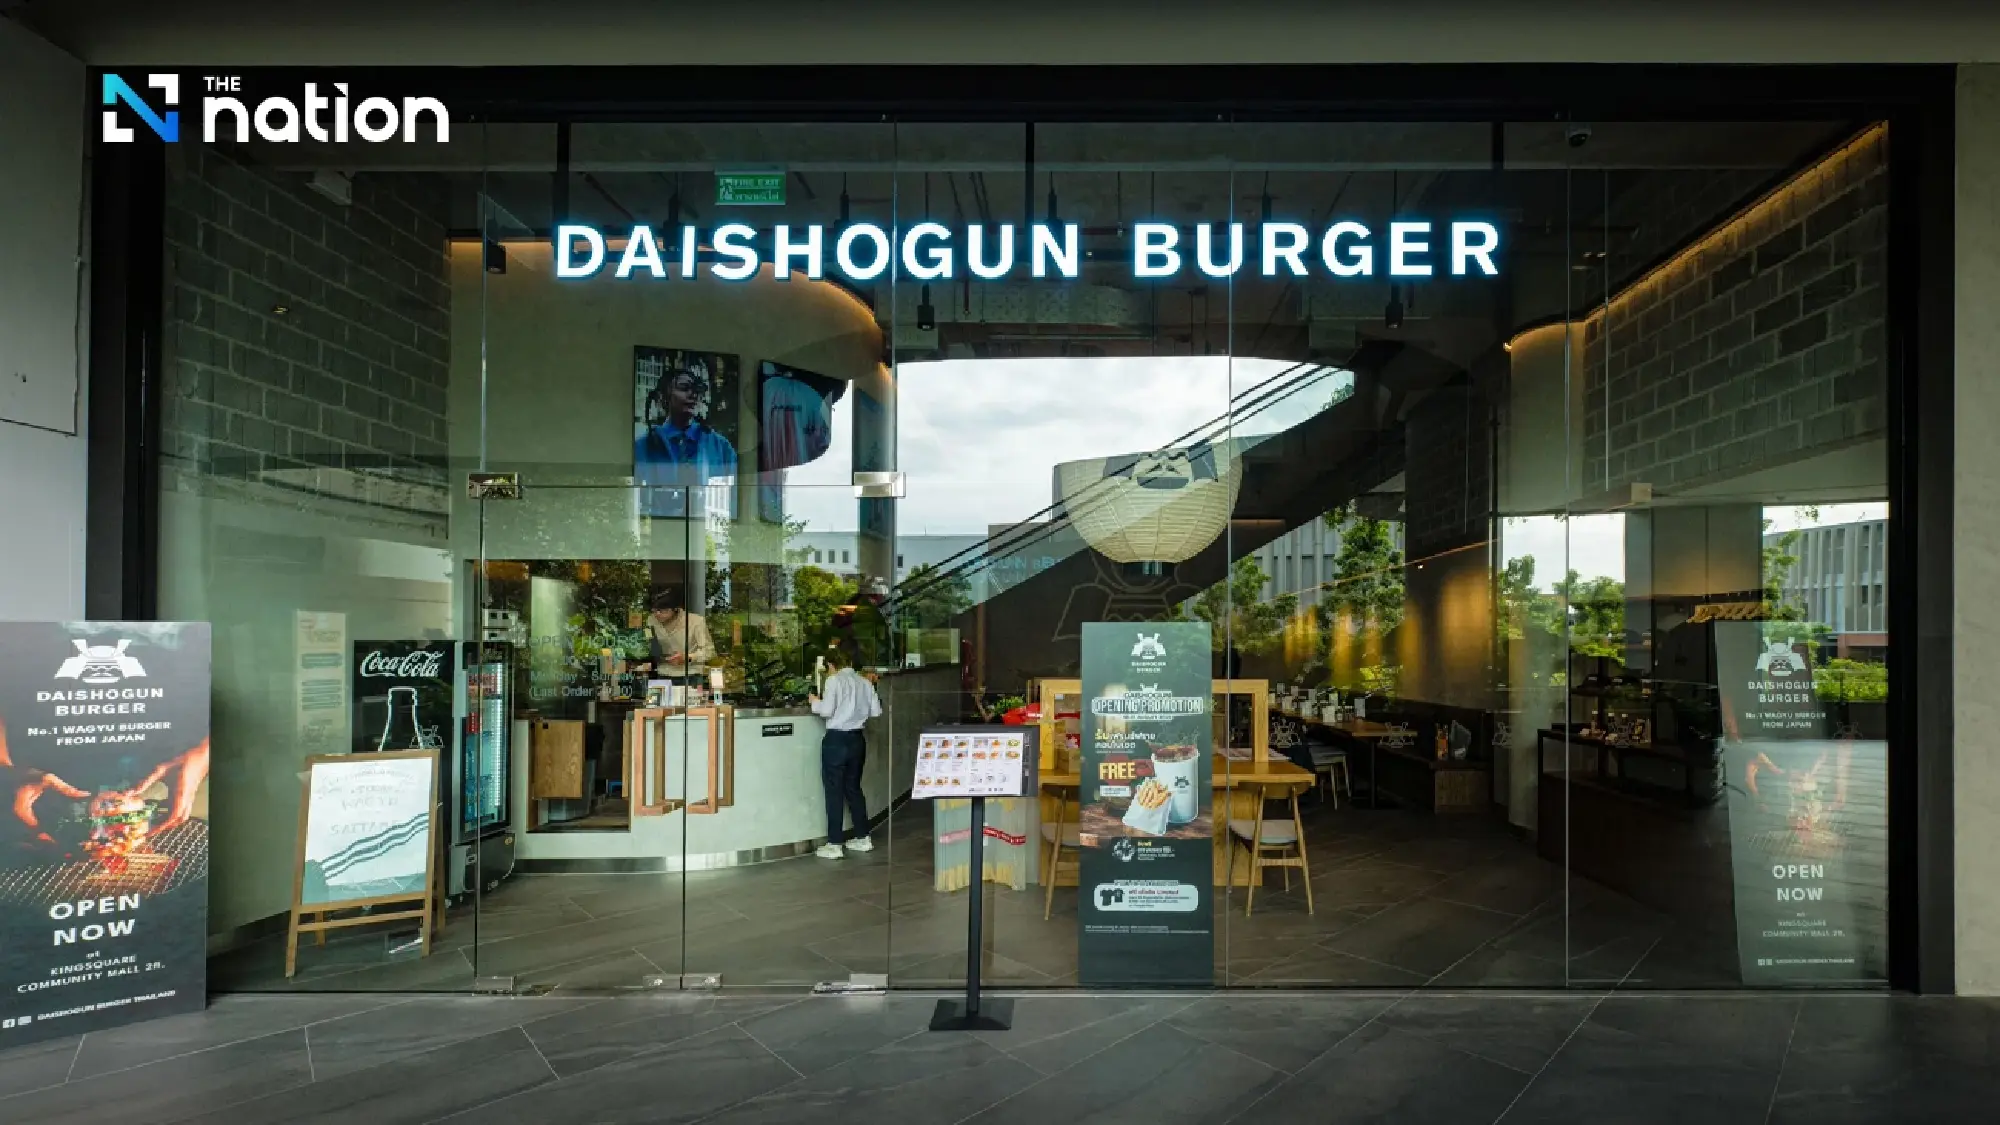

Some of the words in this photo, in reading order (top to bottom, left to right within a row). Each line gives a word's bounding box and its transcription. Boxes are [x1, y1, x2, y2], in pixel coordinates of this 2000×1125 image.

[556, 222, 1079, 280] DAISHOGUN
[1133, 220, 1499, 278] BURGER
[360, 650, 446, 678] Coca-Cola
[1748, 680, 1818, 690] DAISHOGUN
[36, 687, 164, 702] DAISHOGUN
[1759, 693, 1809, 703] BURGER
[54, 702, 146, 716] BURGER
[1093, 699, 1138, 714] OPENING
[1140, 698, 1201, 714] PROMOTION
[27, 727, 58, 737] No.1
[62, 724, 115, 735] WAGYU
[119, 721, 172, 732] BURGER
[56, 735, 96, 746] FROM
[101, 733, 146, 744] JAPAN
[1099, 762, 1137, 780] FREE
[1773, 864, 1824, 880] OPEN
[1777, 887, 1823, 902] NOW
[50, 893, 140, 920] OPEN
[53, 918, 136, 946] NOW
[50, 953, 137, 977] KINGSQUARE
[17, 971, 103, 993] COMMUNITY
[107, 964, 140, 977] MALL
